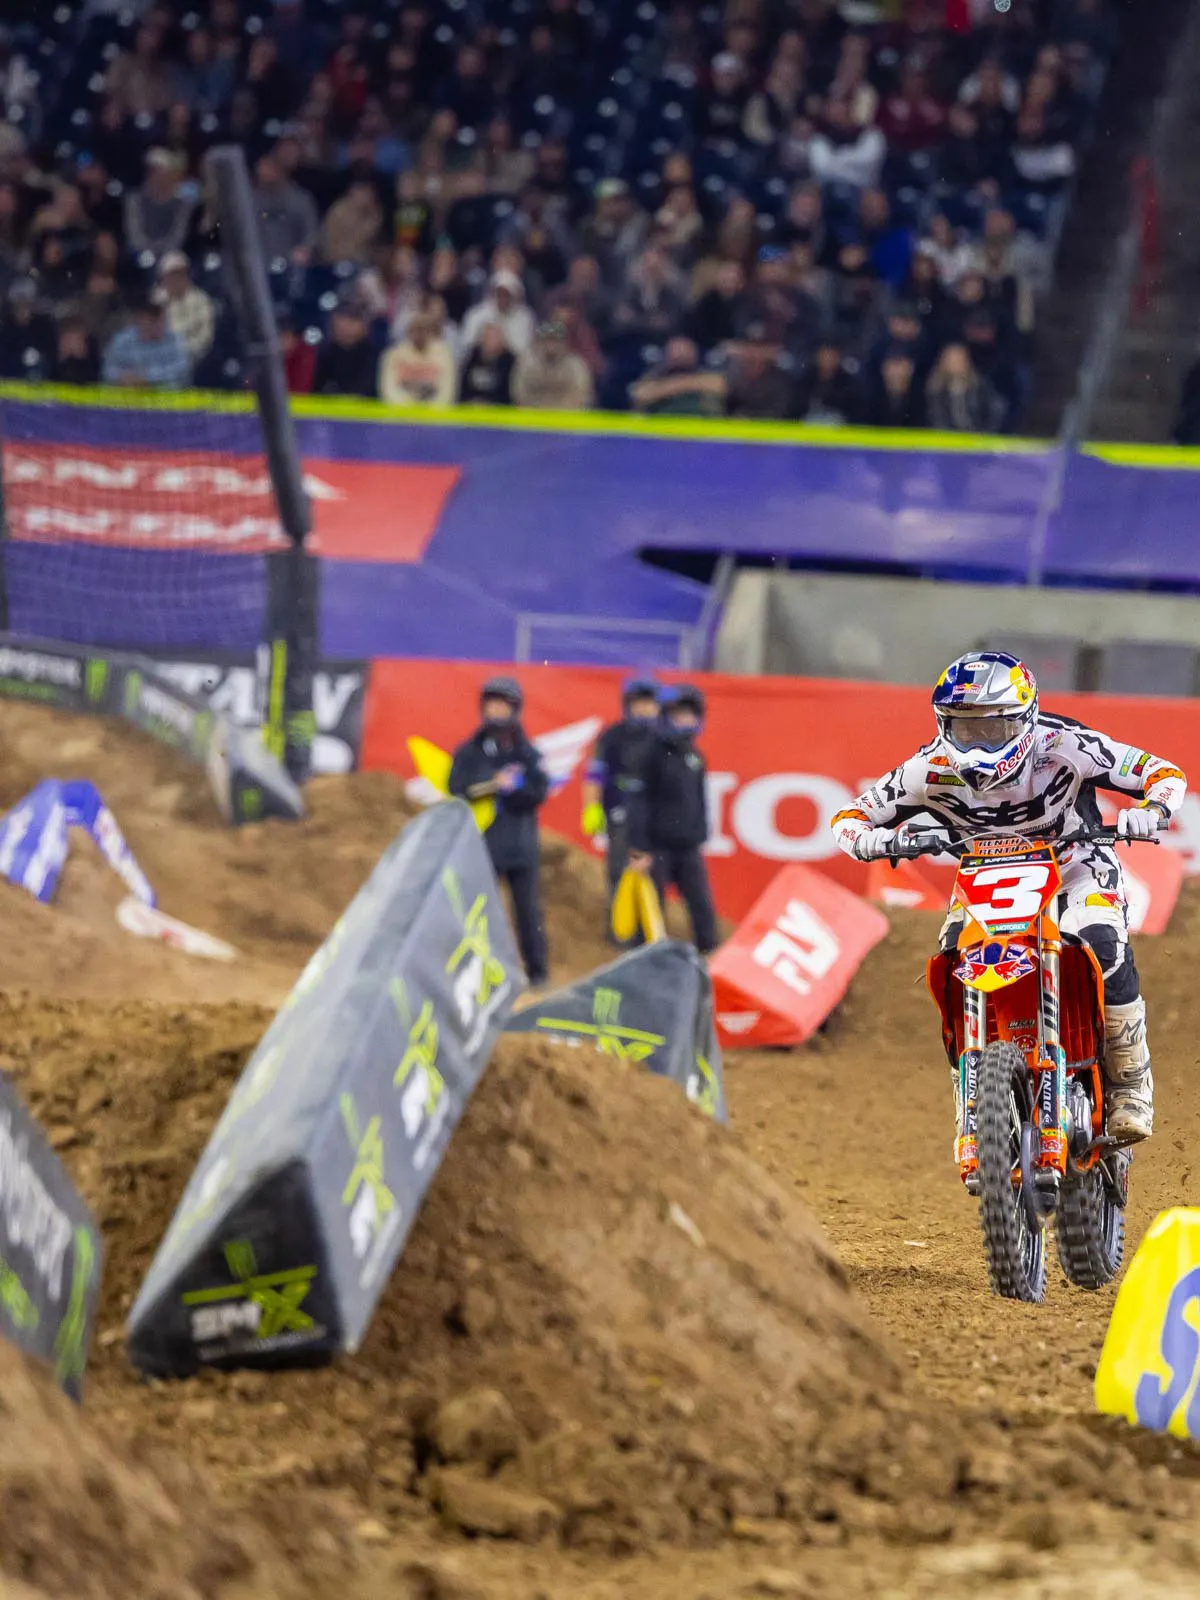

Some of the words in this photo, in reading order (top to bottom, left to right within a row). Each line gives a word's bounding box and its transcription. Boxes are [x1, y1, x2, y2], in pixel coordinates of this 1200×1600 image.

[978, 839, 1021, 847] RENTH
[978, 846, 1032, 855] RENTHA
[967, 866, 1050, 922] 3
[995, 923, 1027, 932] MOTOREX
[969, 1070, 977, 1131] DUNP
